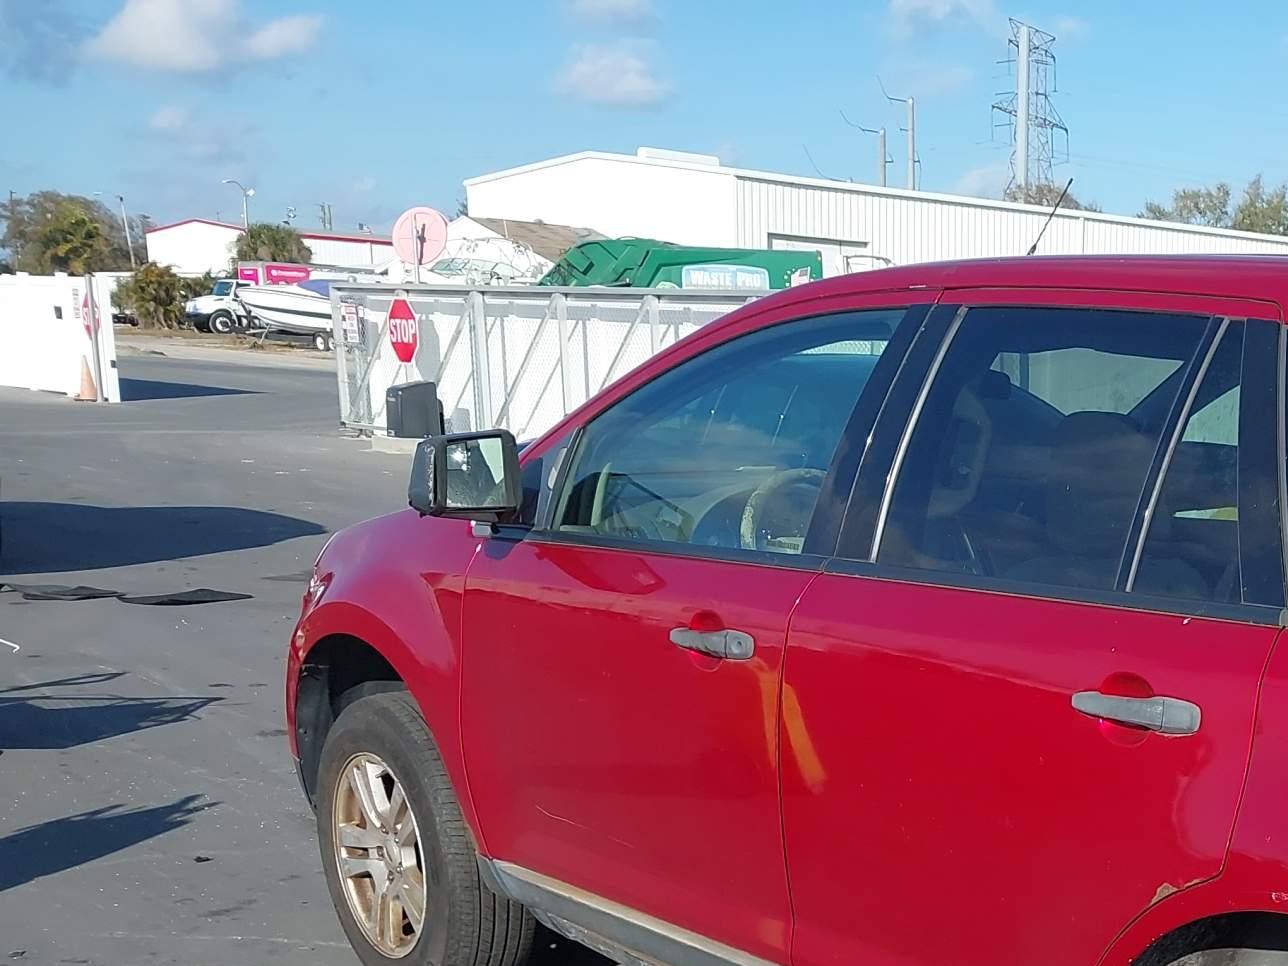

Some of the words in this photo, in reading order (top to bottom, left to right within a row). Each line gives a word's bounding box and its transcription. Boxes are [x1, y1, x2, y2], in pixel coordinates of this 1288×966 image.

[690, 270, 733, 287] WASTE
[736, 271, 761, 287] PRO
[390, 318, 416, 343] STOP
